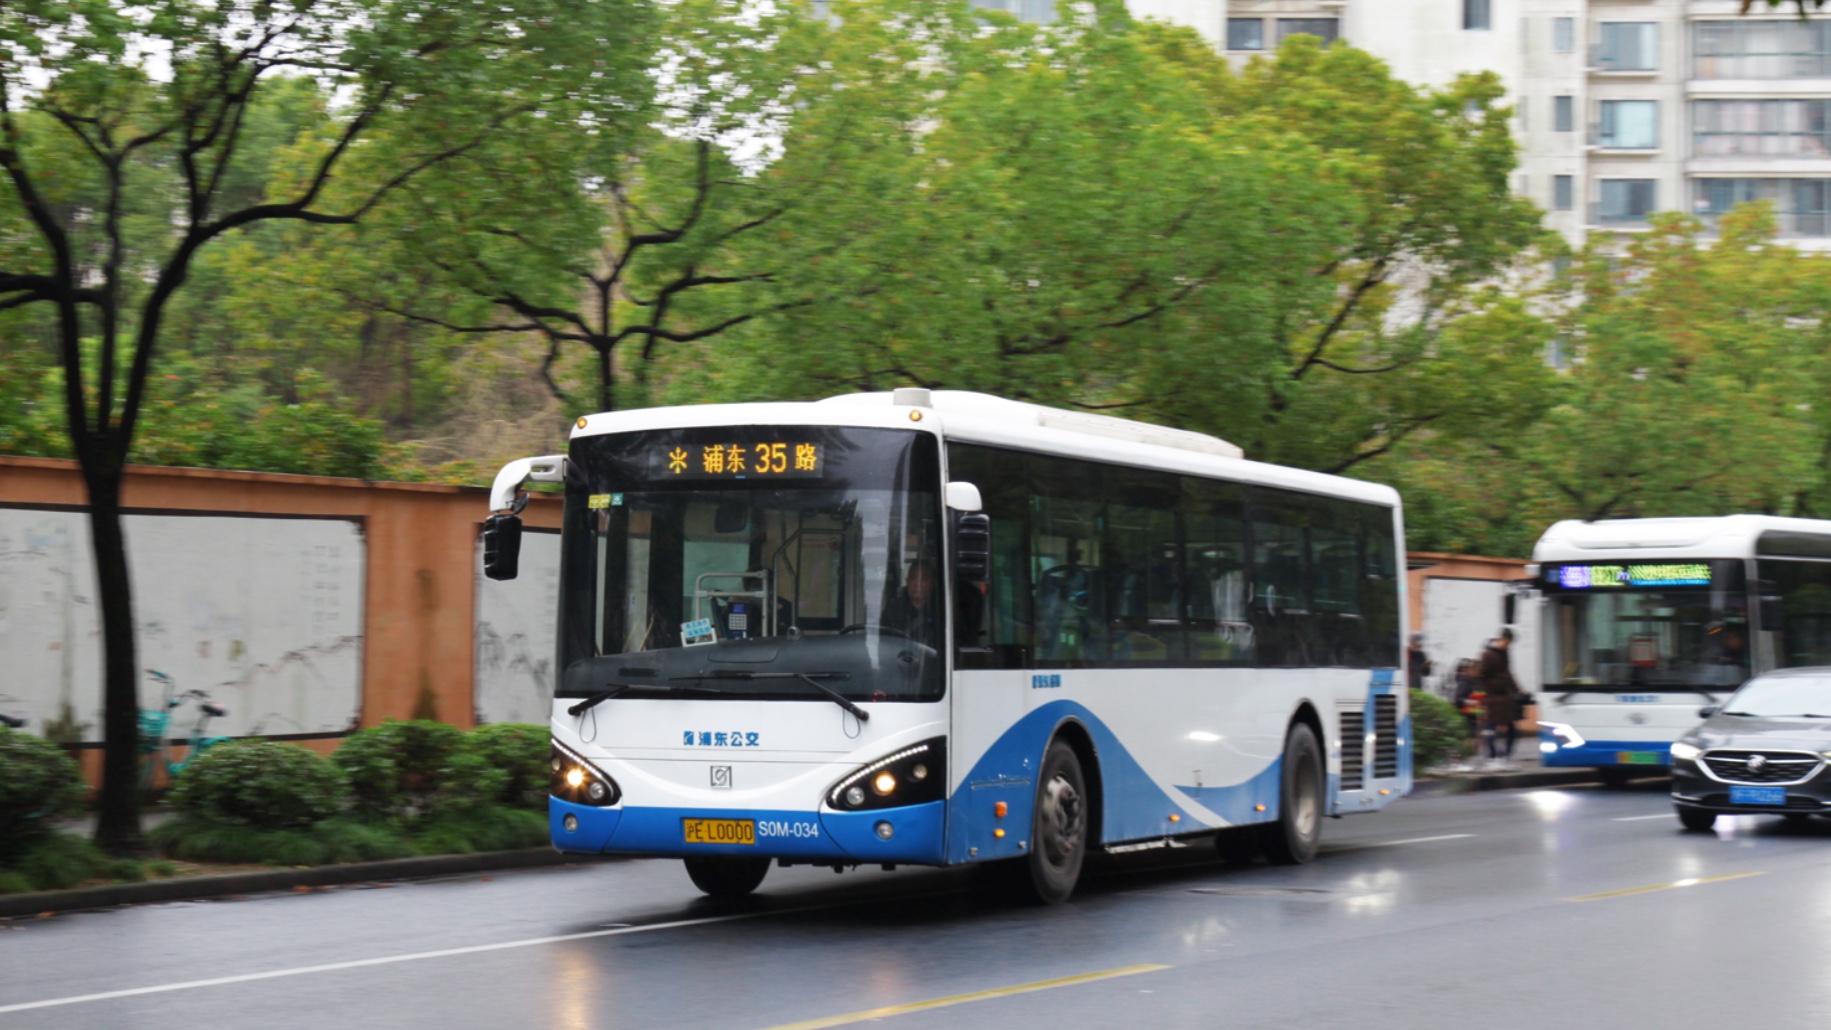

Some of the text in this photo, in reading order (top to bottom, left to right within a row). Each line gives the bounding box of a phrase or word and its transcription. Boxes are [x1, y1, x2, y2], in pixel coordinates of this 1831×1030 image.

[703, 443, 817, 474] 浦东 35 路
[698, 731, 760, 747] 浦东公交
